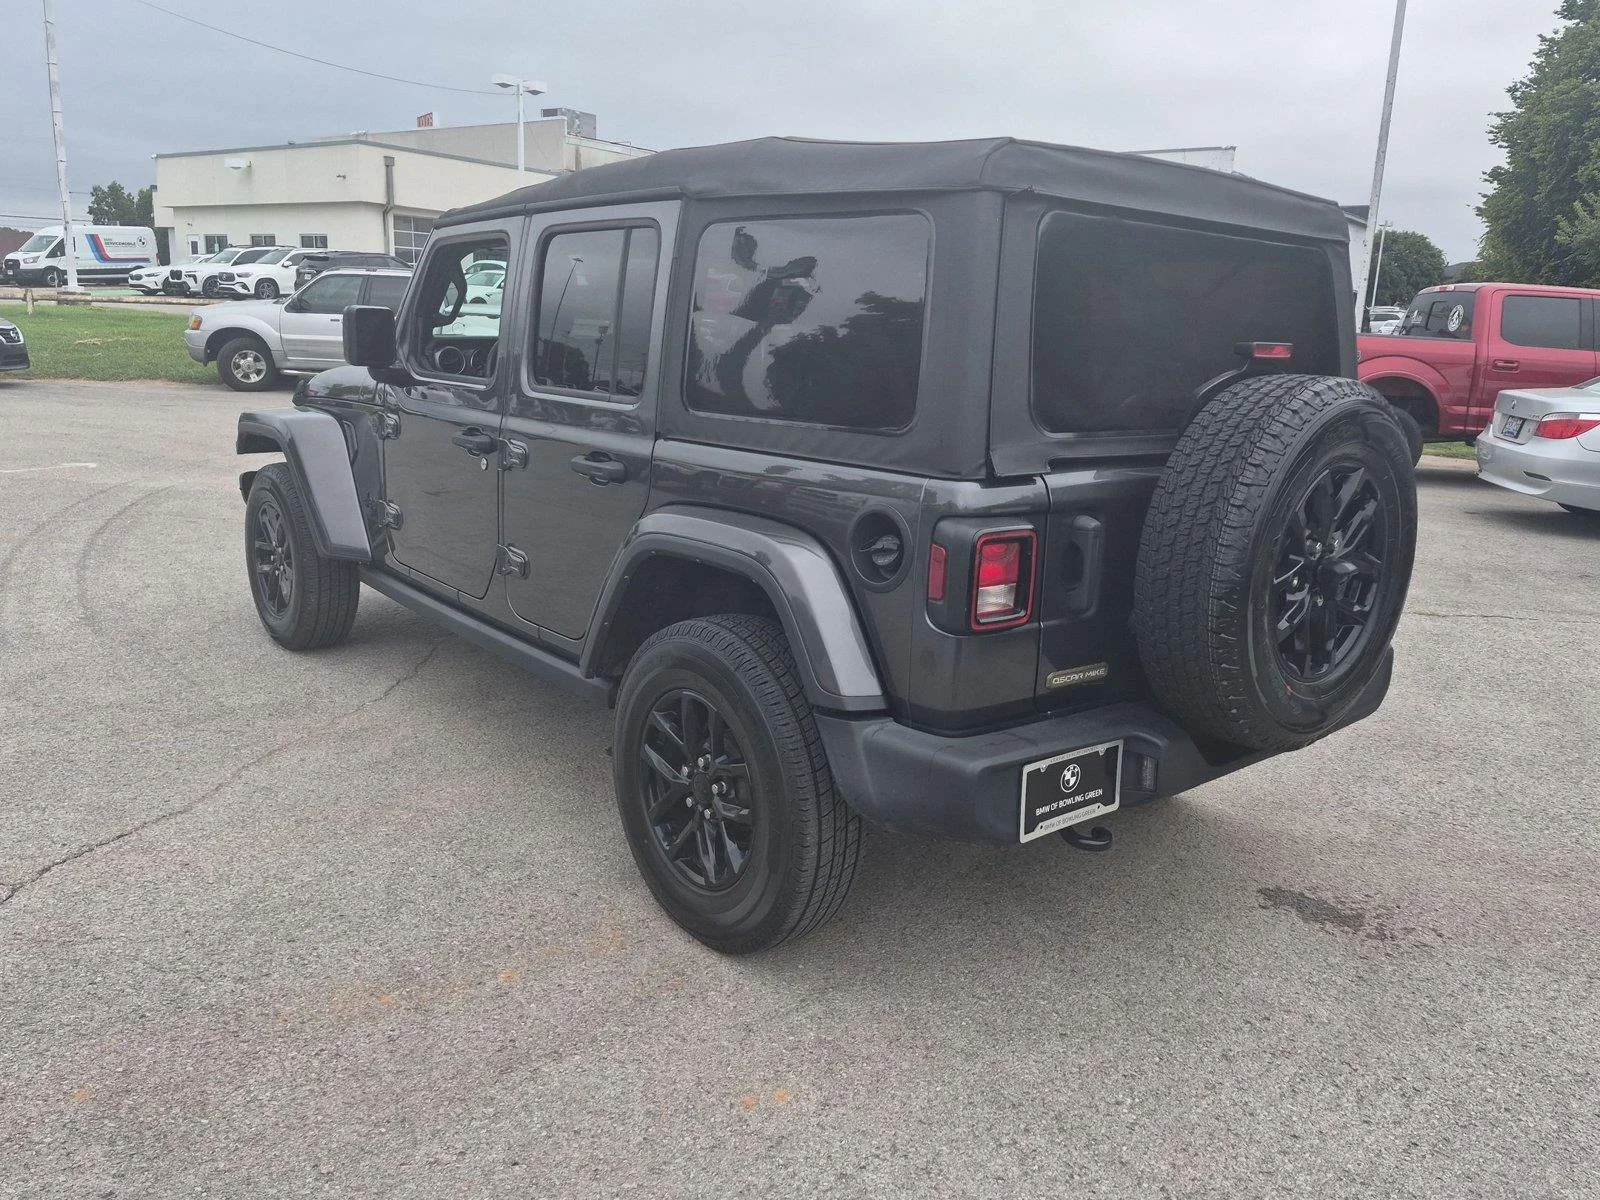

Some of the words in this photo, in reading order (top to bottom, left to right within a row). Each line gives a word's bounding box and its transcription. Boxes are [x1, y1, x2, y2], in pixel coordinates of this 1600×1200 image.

[1052, 672, 1083, 684] OSCAR
[1084, 668, 1105, 678] MIKE
[1035, 804, 1050, 816] BMW
[1050, 802, 1059, 811] OF
[1059, 794, 1084, 808] BOWLING
[1084, 788, 1103, 800] GREEN
